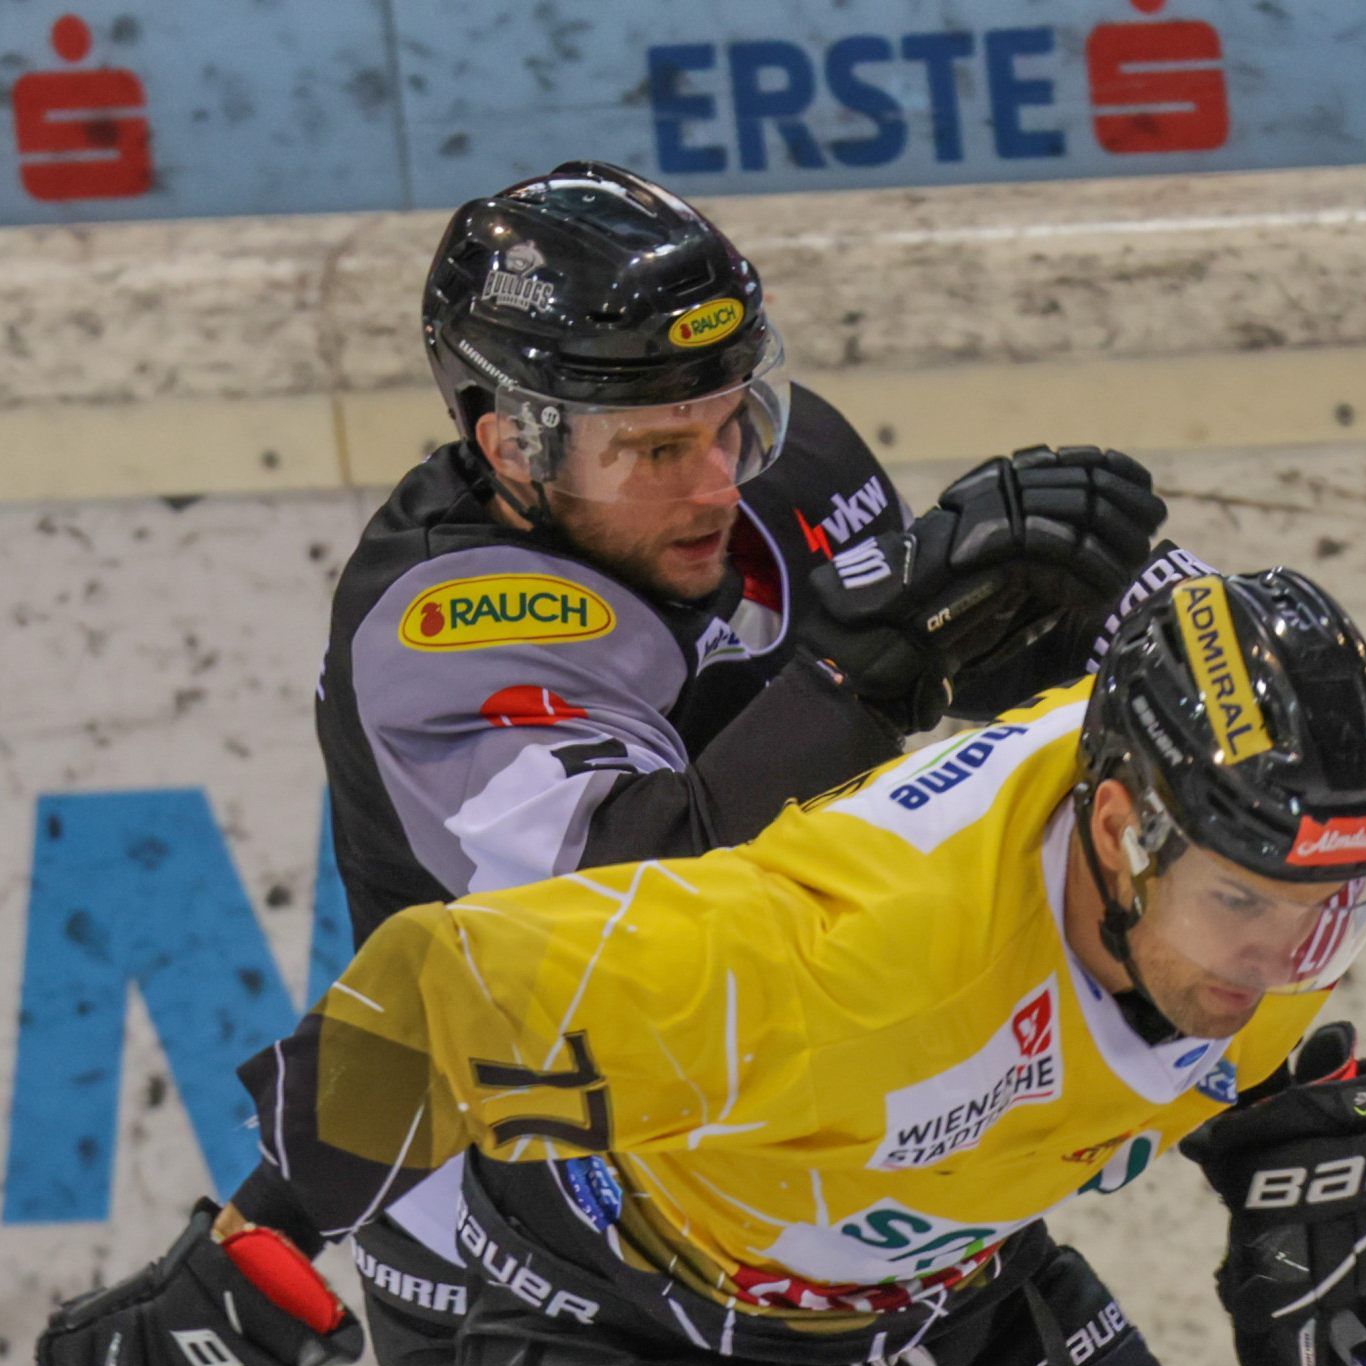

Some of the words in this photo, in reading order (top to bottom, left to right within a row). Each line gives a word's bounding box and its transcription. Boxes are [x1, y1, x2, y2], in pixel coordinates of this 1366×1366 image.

[646, 26, 1067, 176] ERSTE
[690, 304, 737, 336] RAUCH
[820, 475, 889, 544] vkw
[449, 592, 588, 629] RAUCH
[1181, 585, 1255, 756] ADMIRAL
[889, 724, 1029, 811] home
